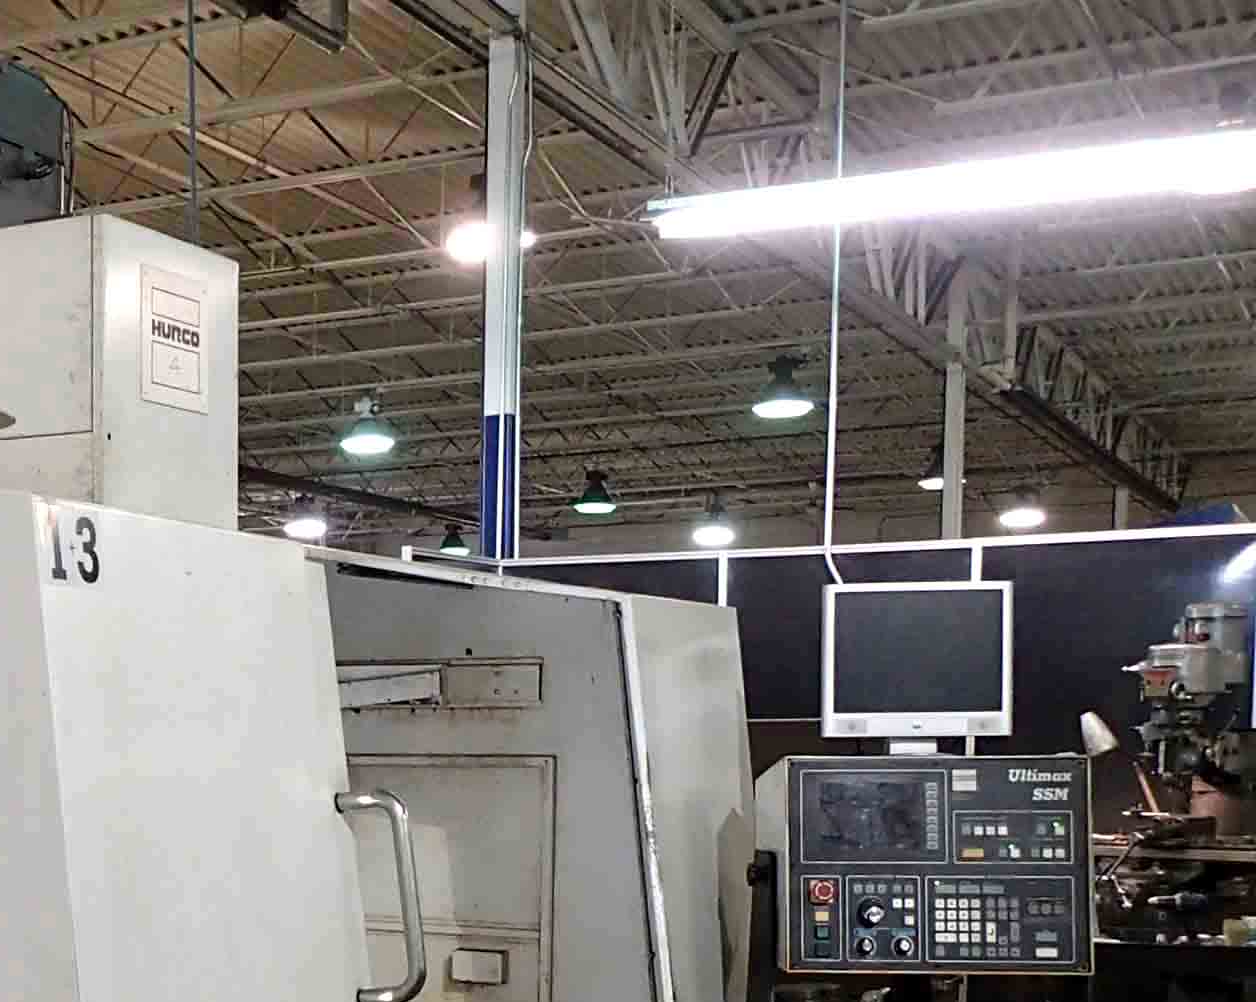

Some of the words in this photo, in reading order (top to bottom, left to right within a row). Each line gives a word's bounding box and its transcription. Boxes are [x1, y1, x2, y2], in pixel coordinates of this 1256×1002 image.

[50, 514, 100, 584] 13
[1008, 768, 1072, 782] Ultimax
[1031, 787, 1069, 801] SSM
